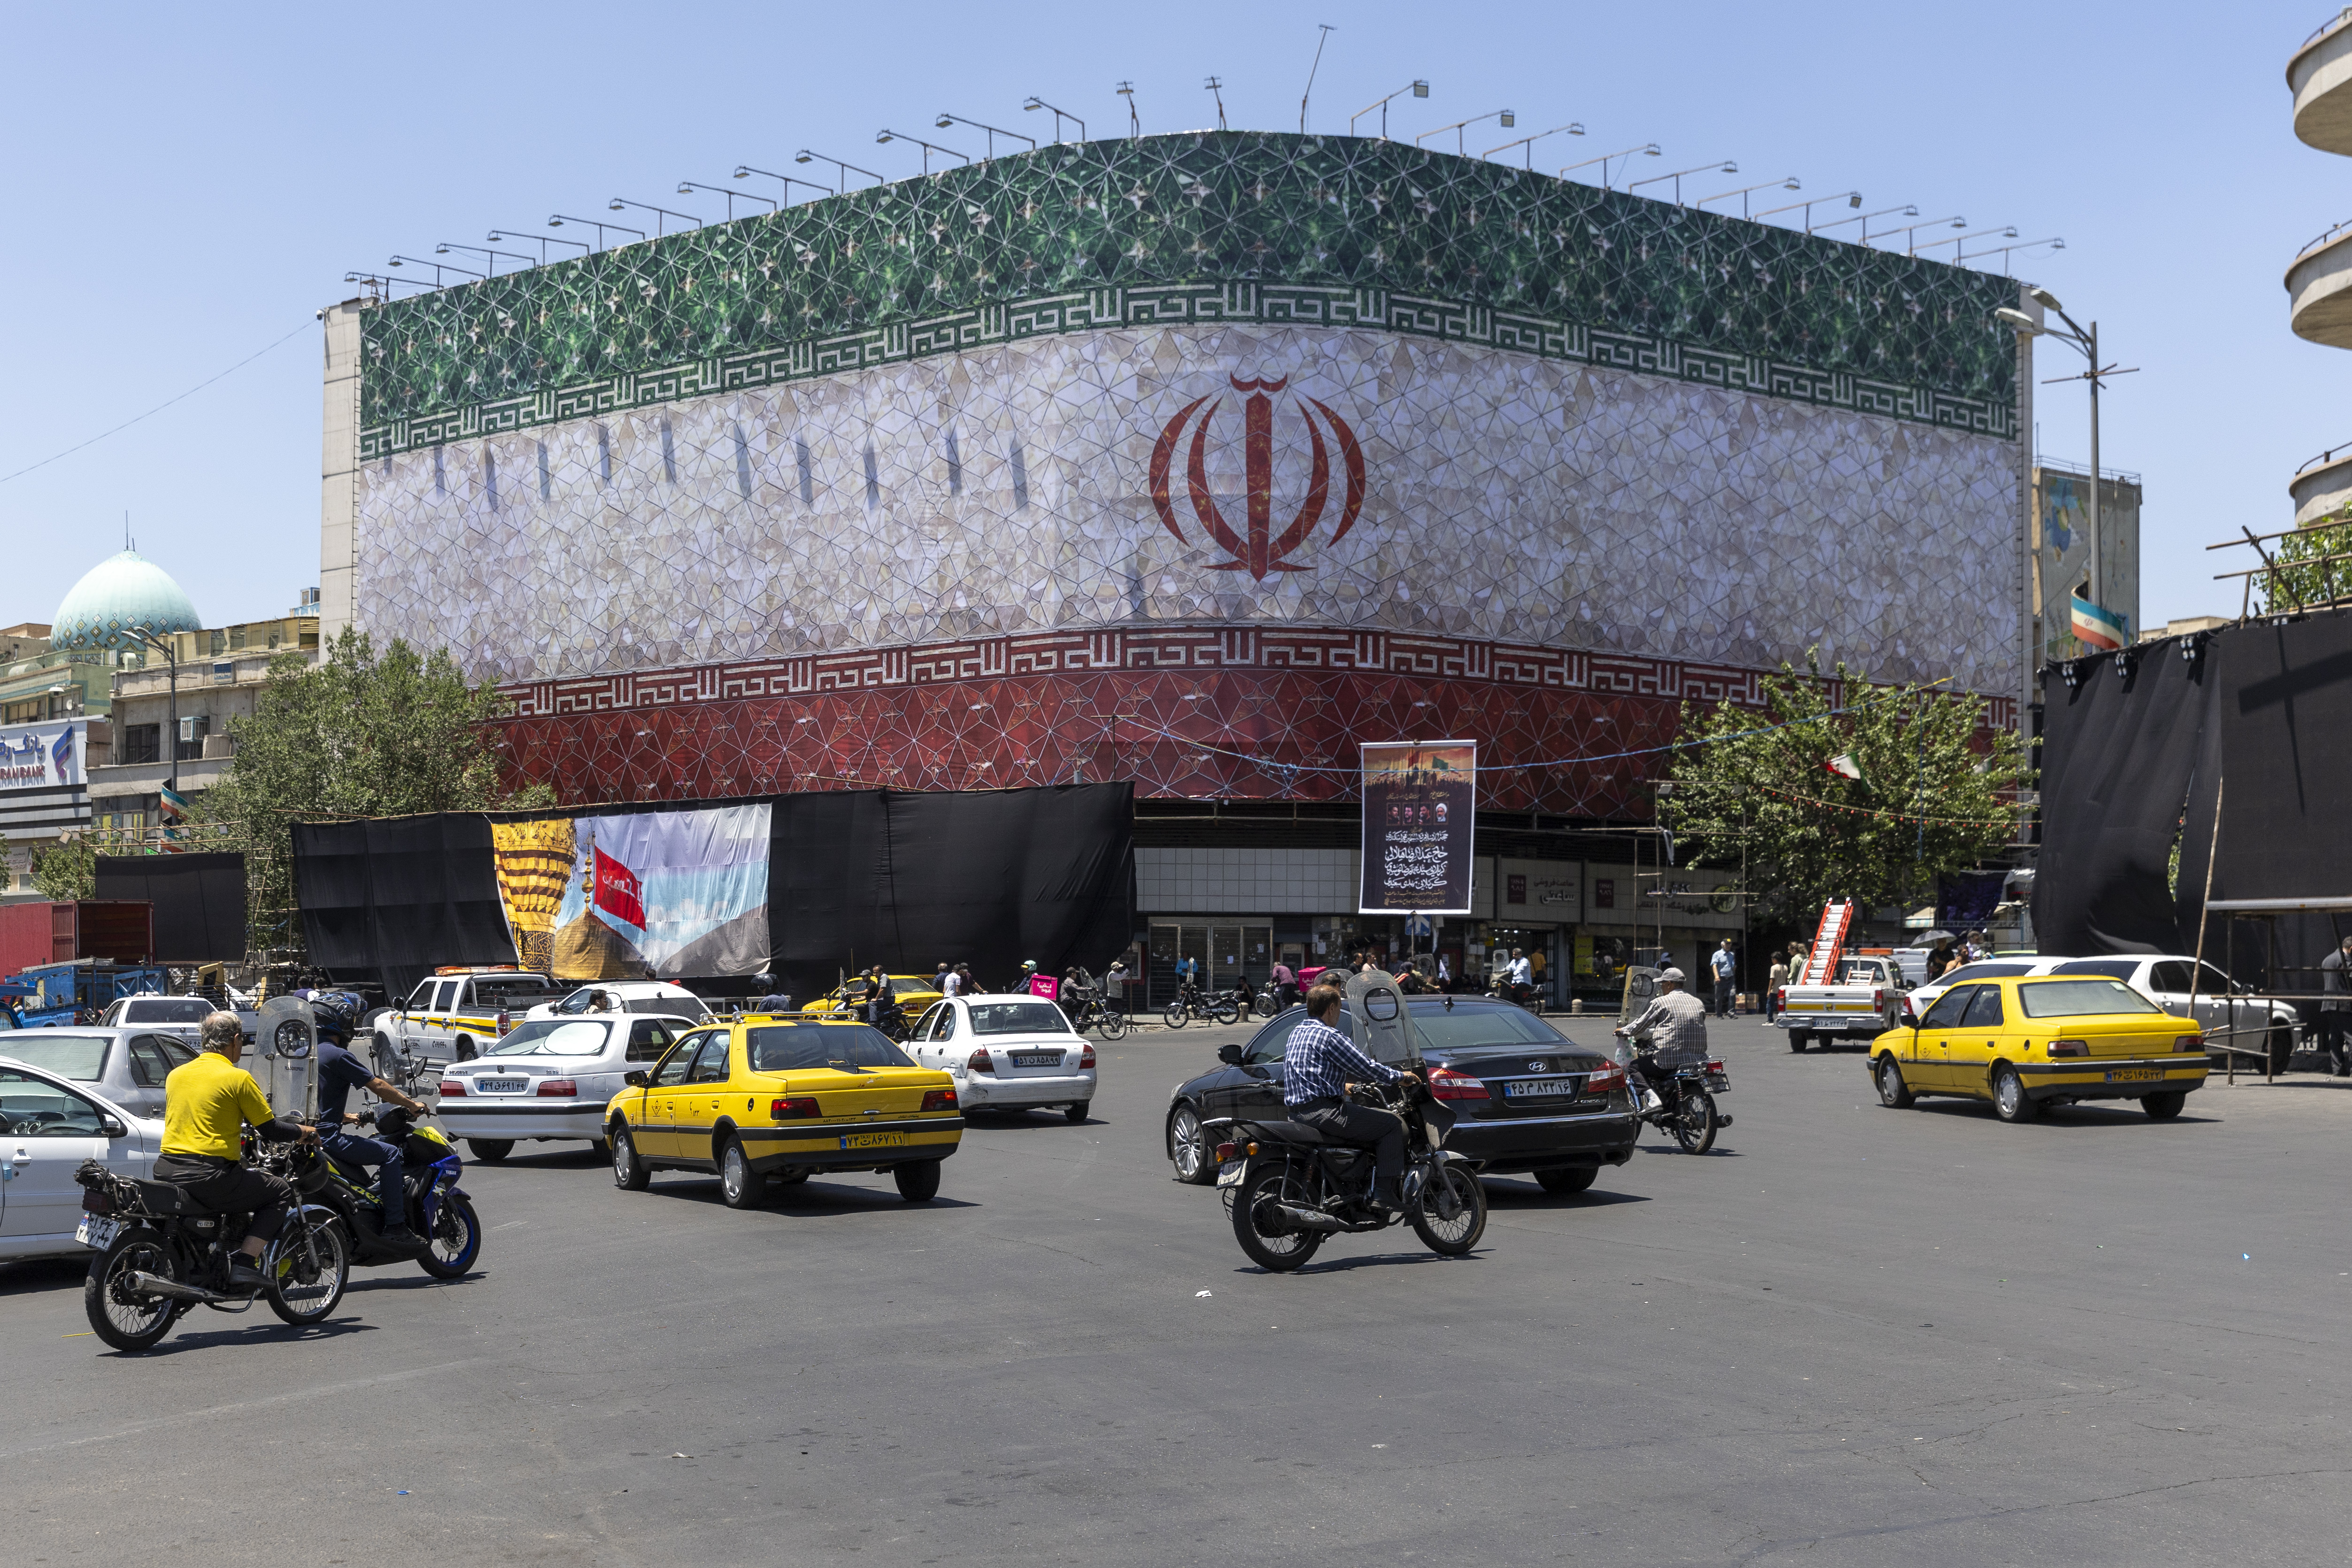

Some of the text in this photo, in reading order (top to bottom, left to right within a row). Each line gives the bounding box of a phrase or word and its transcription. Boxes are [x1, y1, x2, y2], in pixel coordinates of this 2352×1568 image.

[13, 733, 46, 760] بانک
[20, 765, 45, 778] BANK
[1542, 891, 1575, 904] ساعتی
[485, 1081, 524, 1091] ۲۹ ق ۶۹۱ ۴۹
[1511, 1081, 1569, 1095] ۴۵ م ۸۳۳ ۱۶
[847, 1135, 859, 1147] ۷۳
[871, 1134, 889, 1145] ۸۶۷
[893, 1135, 902, 1144] ۱۱
